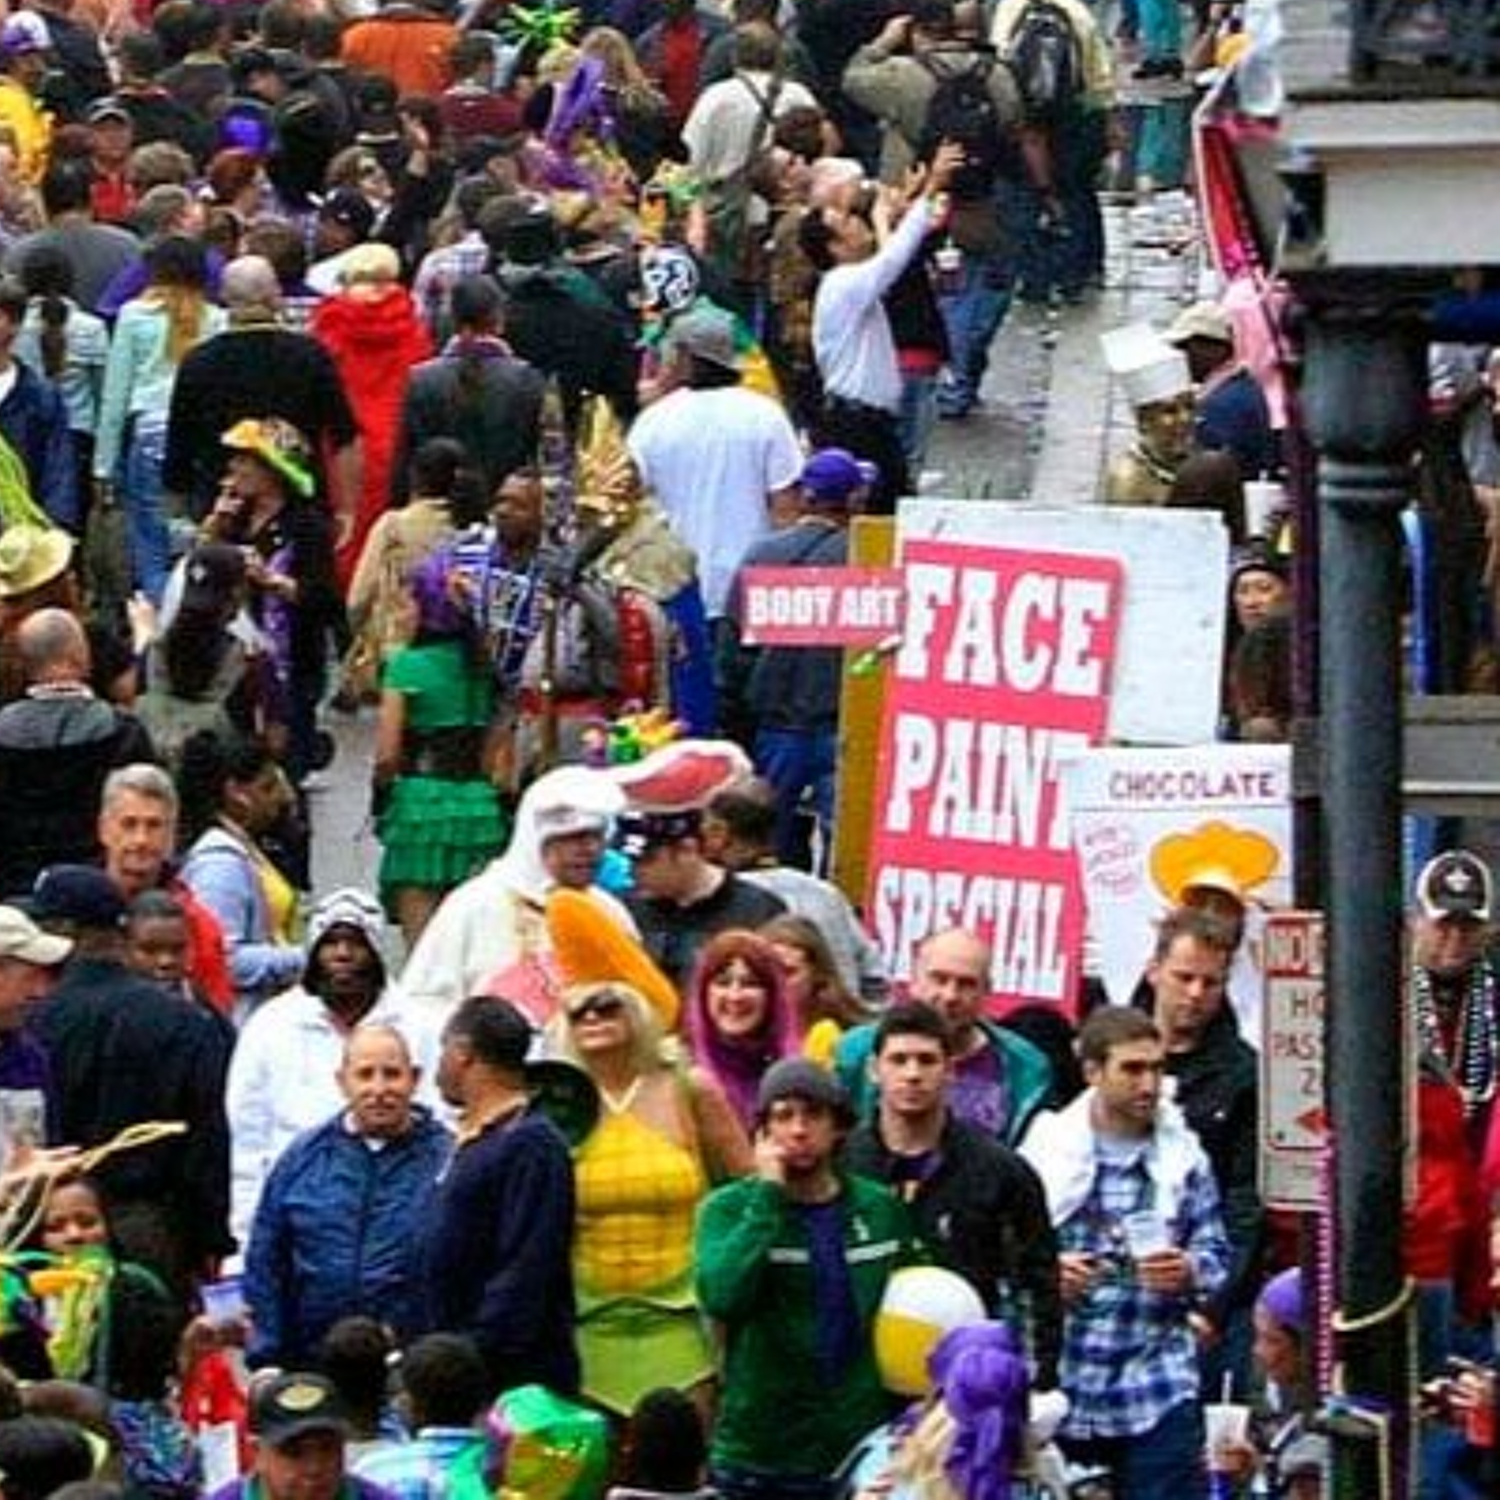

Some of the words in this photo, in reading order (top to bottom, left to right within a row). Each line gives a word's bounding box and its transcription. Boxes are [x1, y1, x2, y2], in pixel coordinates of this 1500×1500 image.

[746, 584, 832, 628] BODY
[838, 584, 900, 628] ART
[894, 560, 1110, 698] FACE
[886, 712, 1092, 851] PAINT
[1108, 771, 1275, 800] CHOCOLATE
